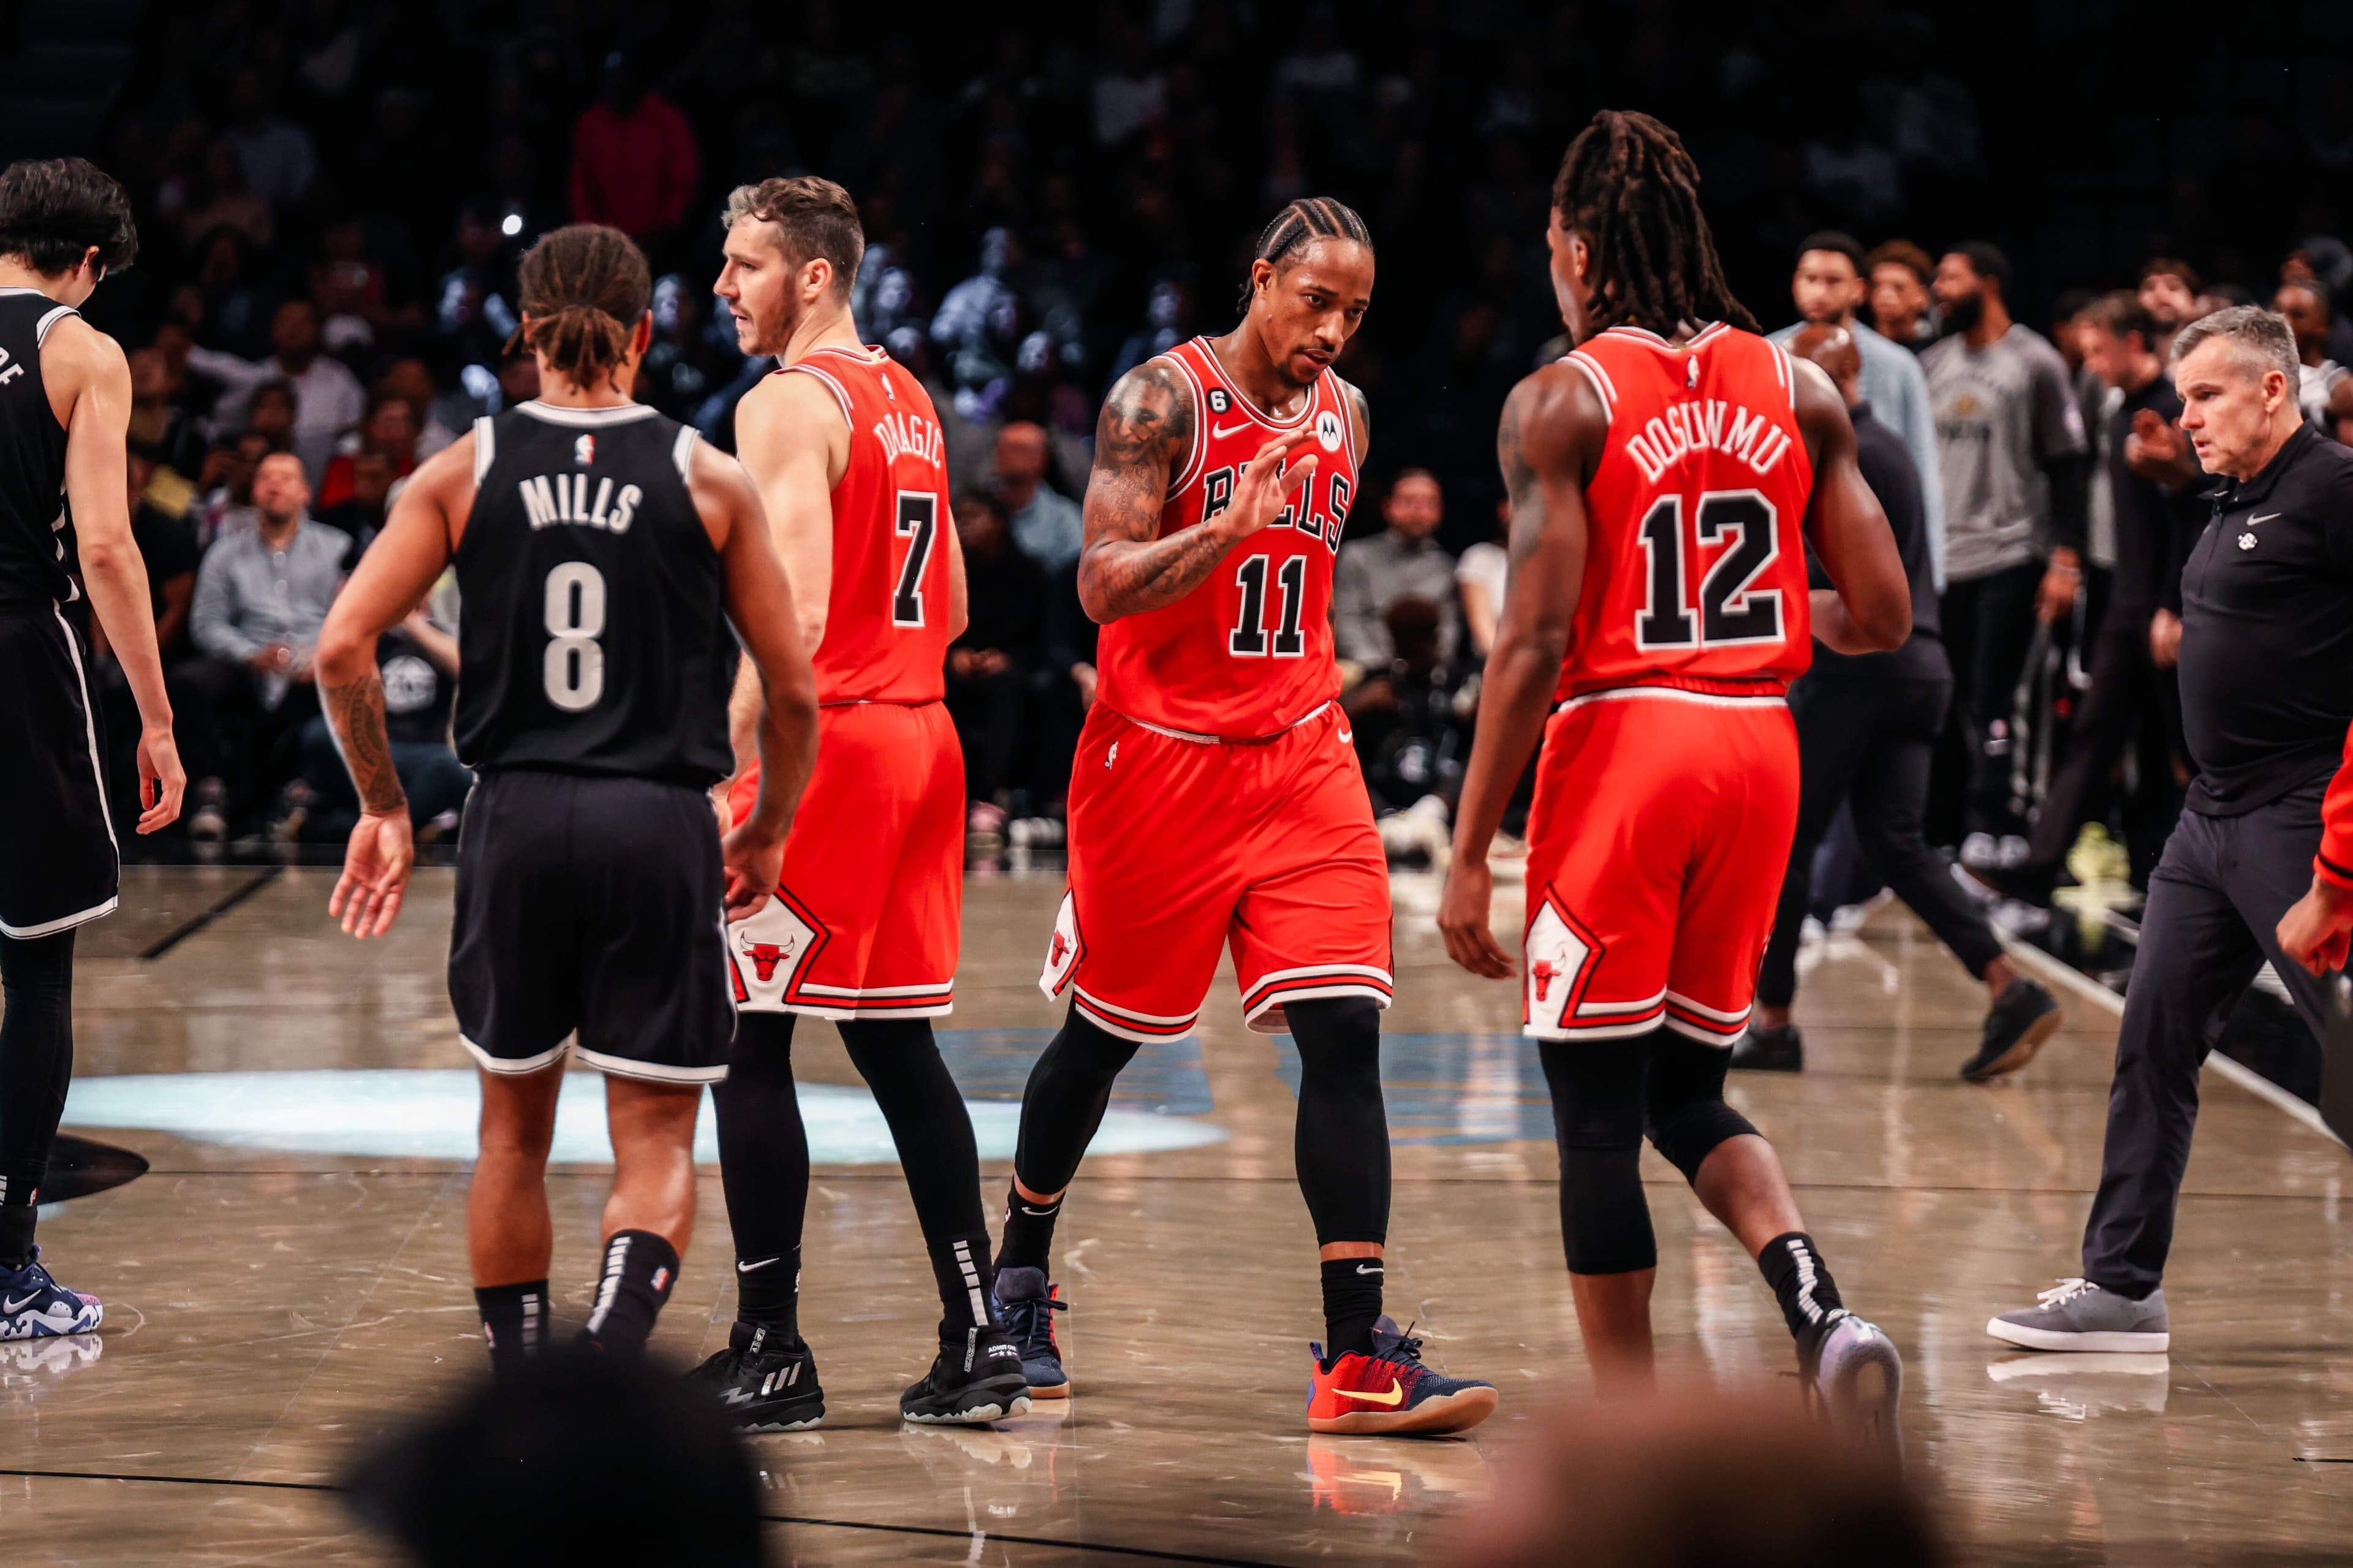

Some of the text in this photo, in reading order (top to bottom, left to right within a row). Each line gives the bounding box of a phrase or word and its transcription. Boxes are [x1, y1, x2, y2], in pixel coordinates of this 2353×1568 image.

[873, 411, 943, 468] DRAGIC
[1211, 390, 1227, 411] 6
[1626, 398, 1792, 482] DOSUNMU
[519, 473, 643, 534] MILLS
[893, 489, 938, 627] 7
[1635, 488, 1786, 651] 12
[544, 561, 607, 713] 8
[1229, 554, 1308, 657] 11
[988, 1344, 1007, 1353] ADMIT
